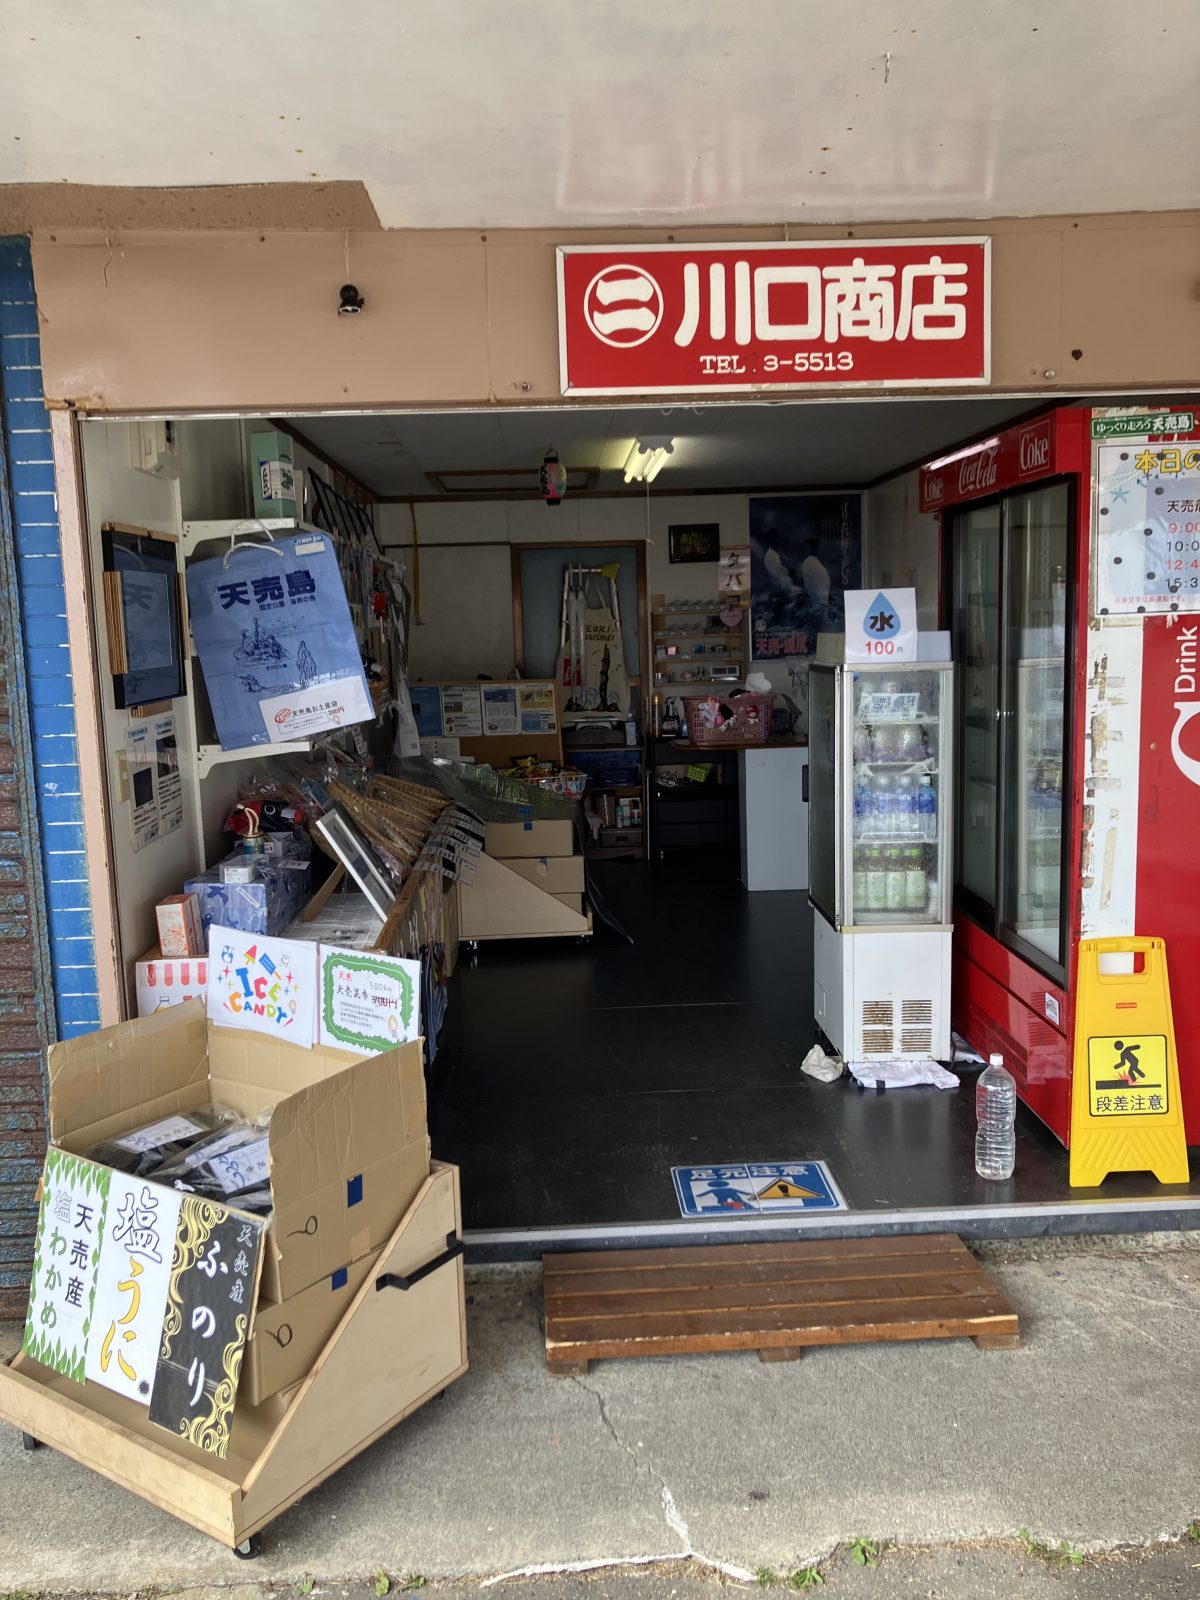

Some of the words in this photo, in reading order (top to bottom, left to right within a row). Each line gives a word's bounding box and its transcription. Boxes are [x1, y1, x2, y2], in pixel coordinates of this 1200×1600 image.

[674, 255, 969, 347] 川口商店
[763, 351, 854, 372] 3-5513
[1020, 433, 1049, 471] Coke
[924, 473, 943, 502] Coke
[217, 569, 316, 610] 天売島
[869, 611, 894, 632] 水
[1174, 625, 1198, 693] Drink
[235, 967, 282, 1002] ICE
[228, 991, 288, 1024] CANDY
[1096, 1094, 1164, 1113] 段差注意
[690, 1165, 809, 1180] 足元注意
[41, 1190, 73, 1330] 塩わかめ
[65, 1204, 94, 1308] 天売産
[99, 1185, 162, 1382] 塩うに
[188, 1241, 228, 1406] ふのり
